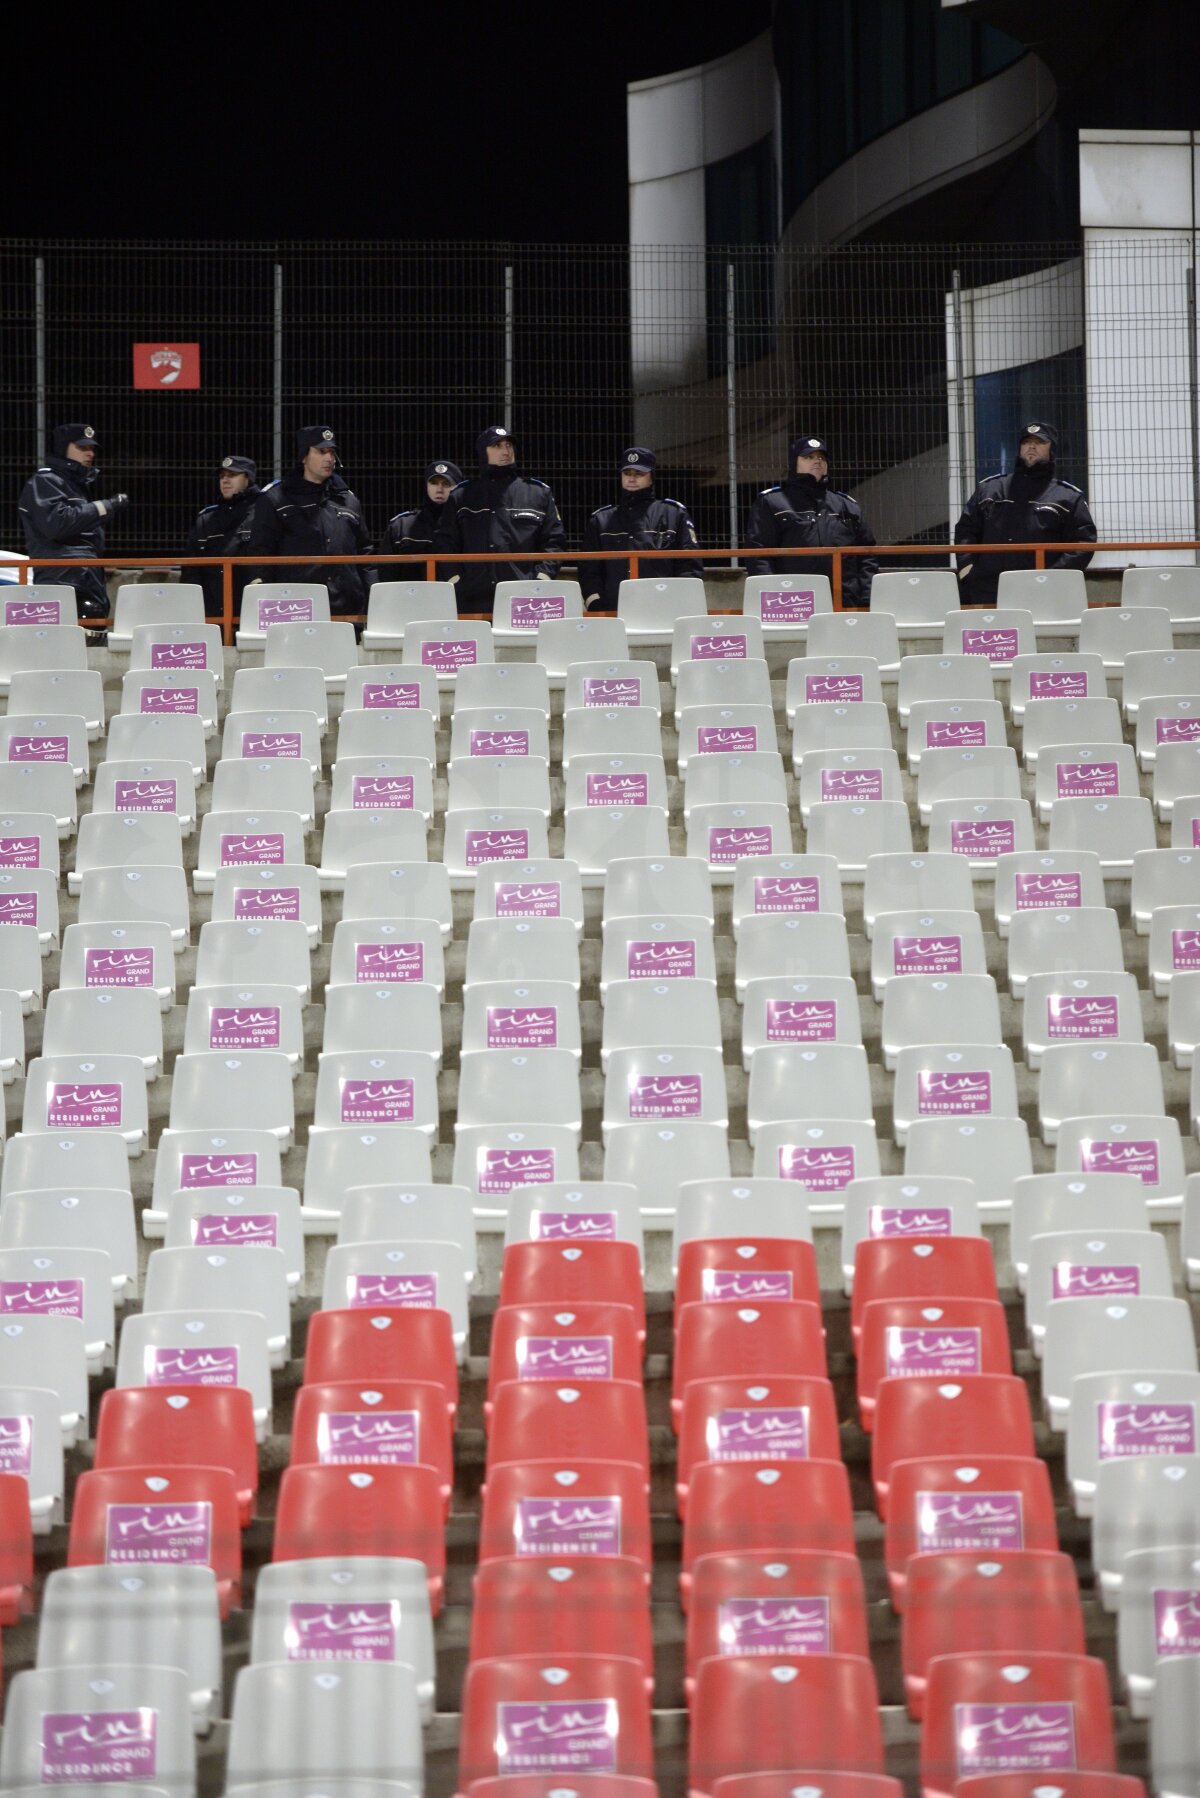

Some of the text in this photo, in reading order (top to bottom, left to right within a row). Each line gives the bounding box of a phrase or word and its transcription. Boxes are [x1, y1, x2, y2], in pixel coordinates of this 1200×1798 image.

[517, 599, 561, 612] rin
[766, 593, 810, 606] rin
[11, 604, 56, 617] rin
[264, 601, 308, 614] rin
[697, 637, 742, 651] rin
[968, 631, 1014, 645] rin
[157, 644, 203, 659] rin
[427, 642, 473, 657] rin
[590, 681, 636, 695] rin
[812, 677, 858, 691] rin
[1036, 674, 1083, 688] rin
[147, 690, 194, 704] rin
[369, 686, 416, 700] rin
[704, 729, 752, 744] rin
[933, 723, 981, 738] rin
[15, 738, 64, 753] rin
[249, 735, 296, 749] rin
[477, 733, 524, 747] rin
[827, 772, 878, 786] rin
[1063, 765, 1113, 780] rin
[122, 782, 172, 798] rin
[360, 778, 409, 794] rin
[594, 776, 642, 790] rin
[716, 829, 767, 845] rin
[958, 823, 1009, 838] rin
[228, 836, 279, 852] rin
[472, 832, 523, 848] rin
[761, 879, 814, 895] rin
[1022, 876, 1076, 892] rin
[242, 890, 295, 906] rin
[502, 885, 555, 901] rin
[363, 945, 418, 963] rin
[635, 943, 690, 960] rin
[901, 939, 956, 956] rin
[93, 950, 148, 968] rin
[88, 976, 139, 984] RESIDENCE
[358, 971, 410, 979] RESIDENCE
[218, 1010, 275, 1027] rin
[494, 1010, 551, 1027] rin
[774, 1003, 831, 1020] rin
[56, 1086, 116, 1104] rin
[349, 1082, 408, 1100] rin
[385, 1101, 410, 1109] GRAND
[343, 1110, 399, 1118] RESIDENCE
[189, 1156, 251, 1175] rin
[487, 1152, 548, 1170] rin
[1127, 1164, 1155, 1172] GRAND
[203, 1217, 271, 1238] rin
[543, 1215, 609, 1236] rin
[360, 1277, 430, 1298] rin
[714, 1274, 784, 1297] rin
[6, 1283, 78, 1306] rin
[530, 1341, 604, 1364] rin
[157, 1350, 231, 1373] rin
[943, 1358, 975, 1367] GRAND
[575, 1366, 606, 1375] GRAND
[202, 1375, 233, 1384] GRAND
[332, 1416, 409, 1440] rin
[720, 1413, 799, 1437] rin
[768, 1440, 802, 1449] GRAND
[1156, 1433, 1190, 1443] GRAND
[379, 1443, 412, 1453] GRAND
[324, 1455, 397, 1464] RESIDENCE
[119, 1508, 202, 1534] rin
[528, 1502, 611, 1528] rin
[300, 1605, 387, 1633] rin
[512, 1705, 604, 1737] rin
[54, 1714, 147, 1746] rin
